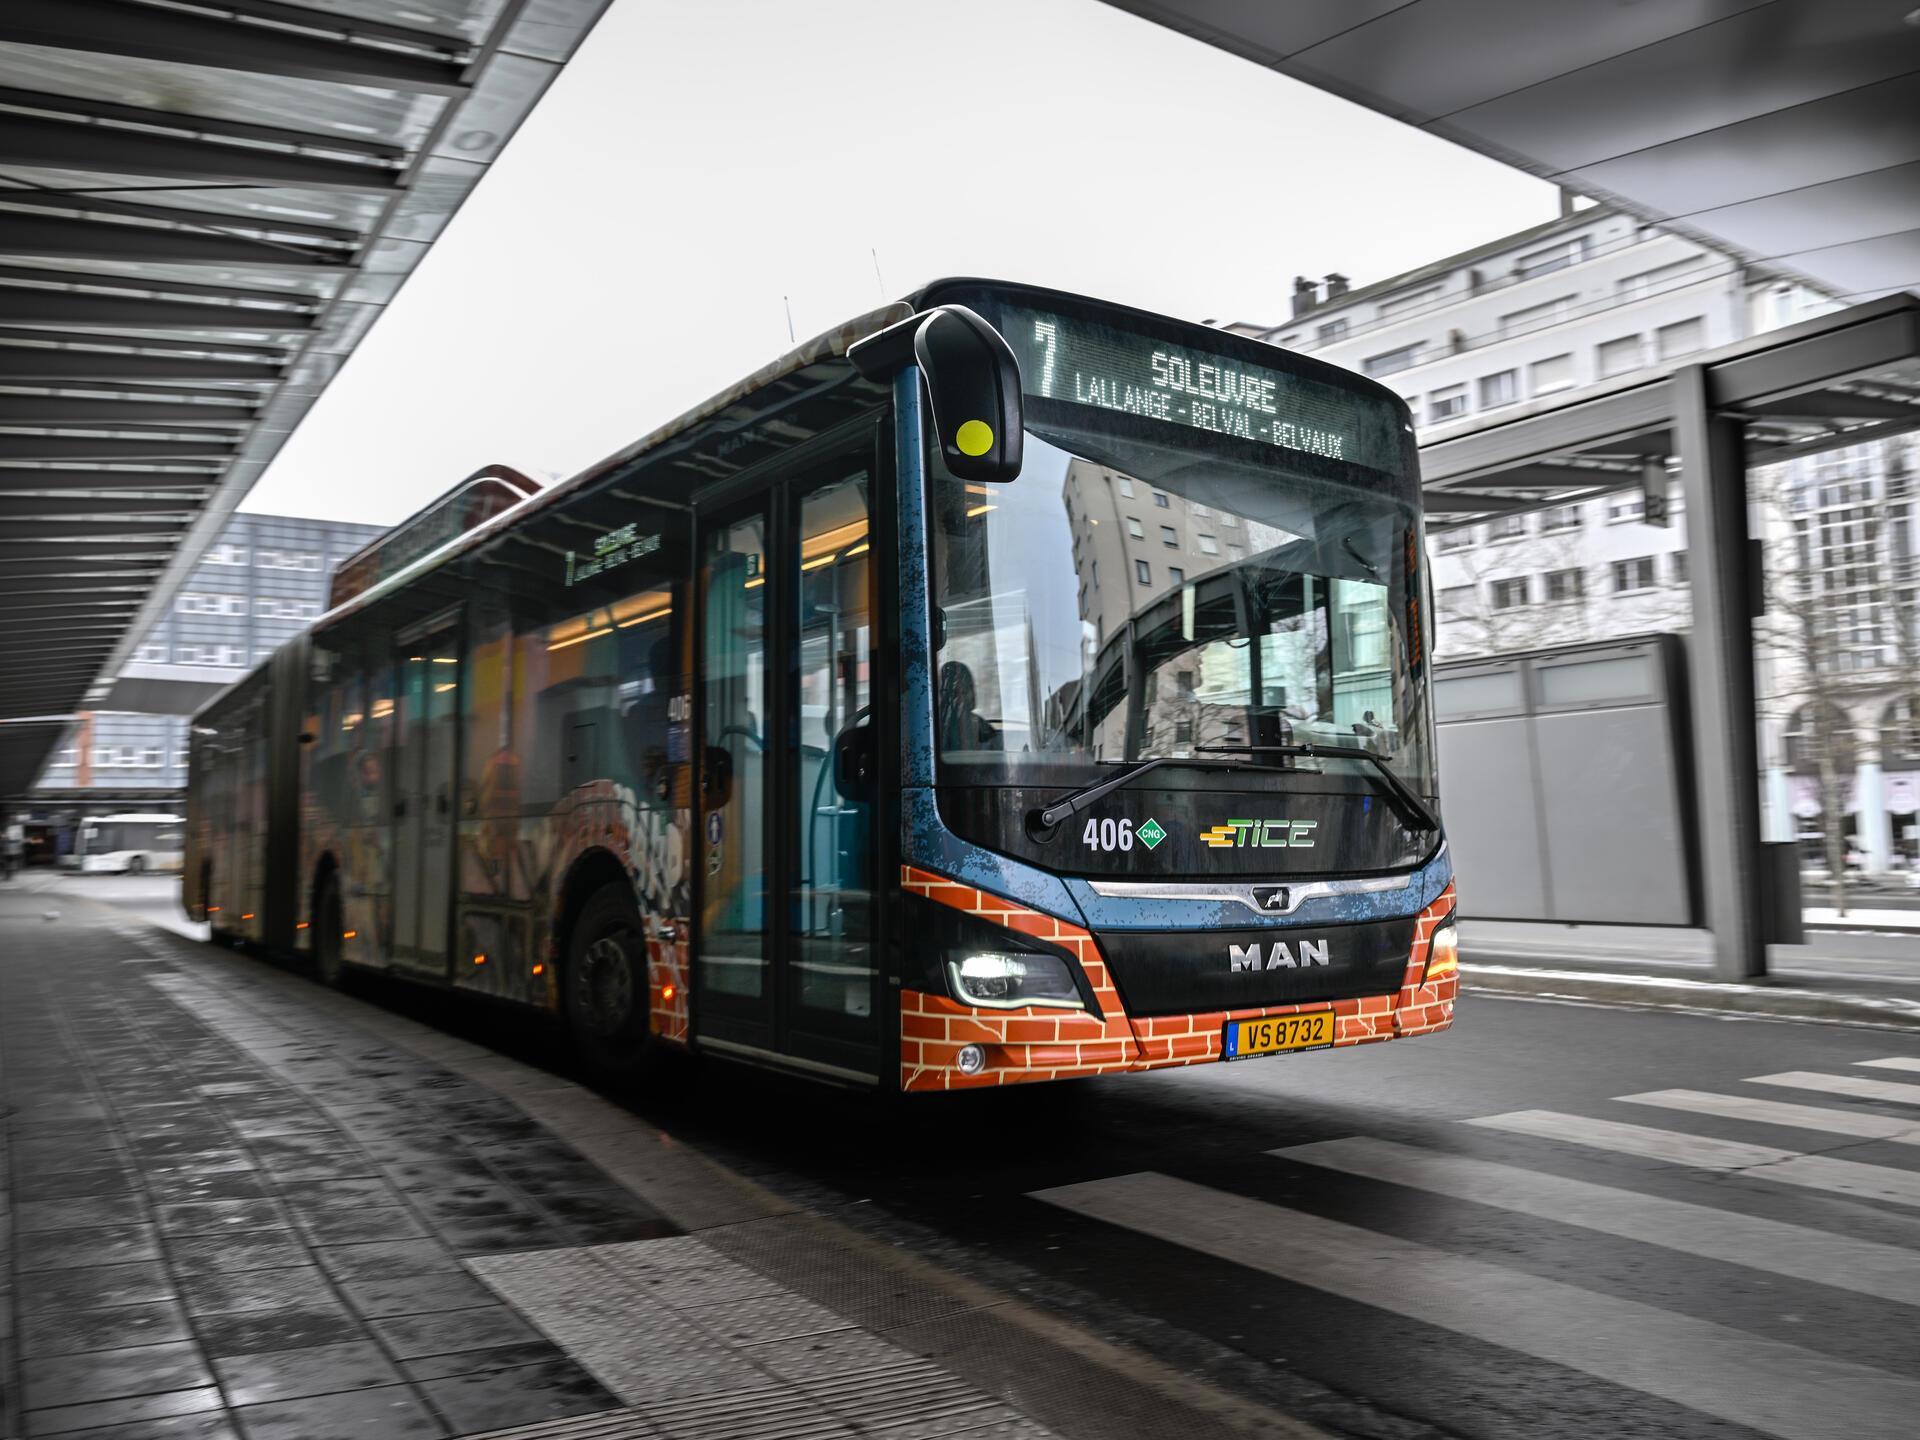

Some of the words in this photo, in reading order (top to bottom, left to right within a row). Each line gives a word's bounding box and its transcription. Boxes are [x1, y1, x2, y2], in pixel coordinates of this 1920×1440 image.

[1034, 320, 1056, 398] 7
[1151, 351, 1277, 414] SOLEUVRE
[1076, 372, 1172, 421] LALLANGE
[1192, 400, 1256, 440] BELVAL
[1272, 420, 1344, 462] BELVAUX
[1083, 818, 1133, 852] 406
[1142, 829, 1161, 839] CNG
[1229, 939, 1329, 972] MAN
[1229, 1042, 1235, 1052] L
[1248, 1024, 1272, 1049] VS
[1275, 1017, 1324, 1045] 8732
